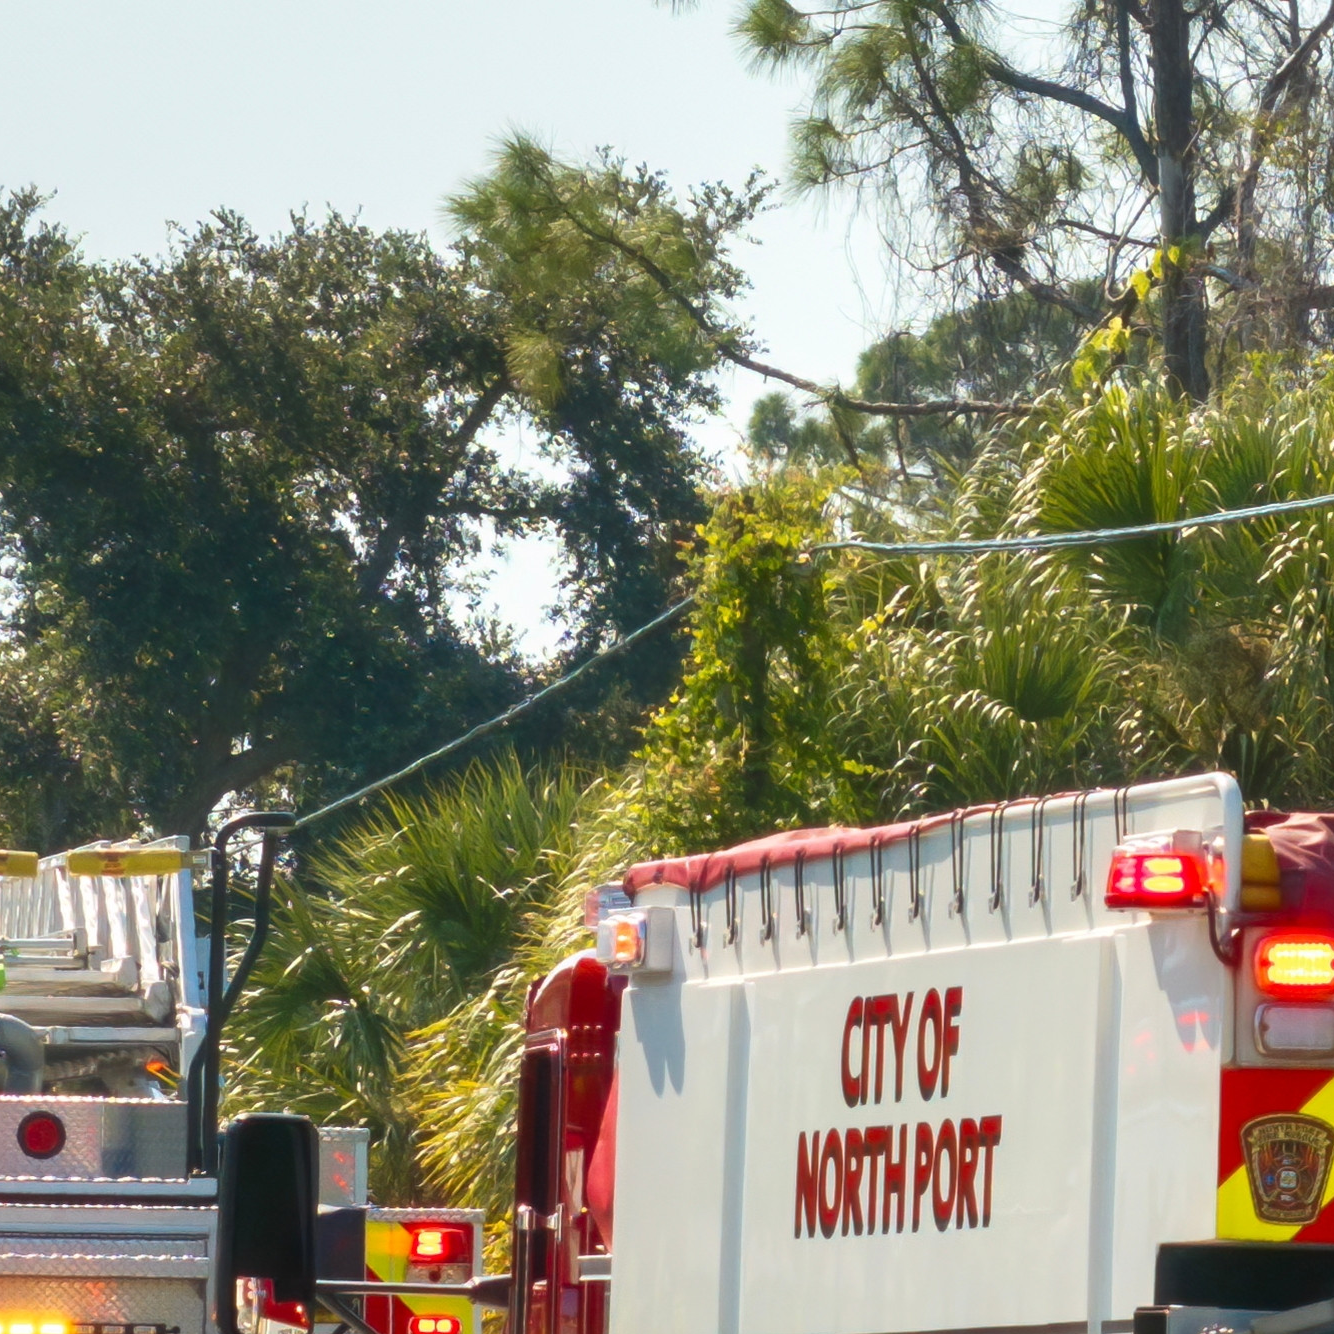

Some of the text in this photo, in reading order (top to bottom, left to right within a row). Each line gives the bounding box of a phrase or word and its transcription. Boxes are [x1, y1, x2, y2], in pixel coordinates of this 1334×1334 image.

[841, 985, 963, 1108] CITY OF
[794, 1114, 1002, 1240] NORTH PORT
